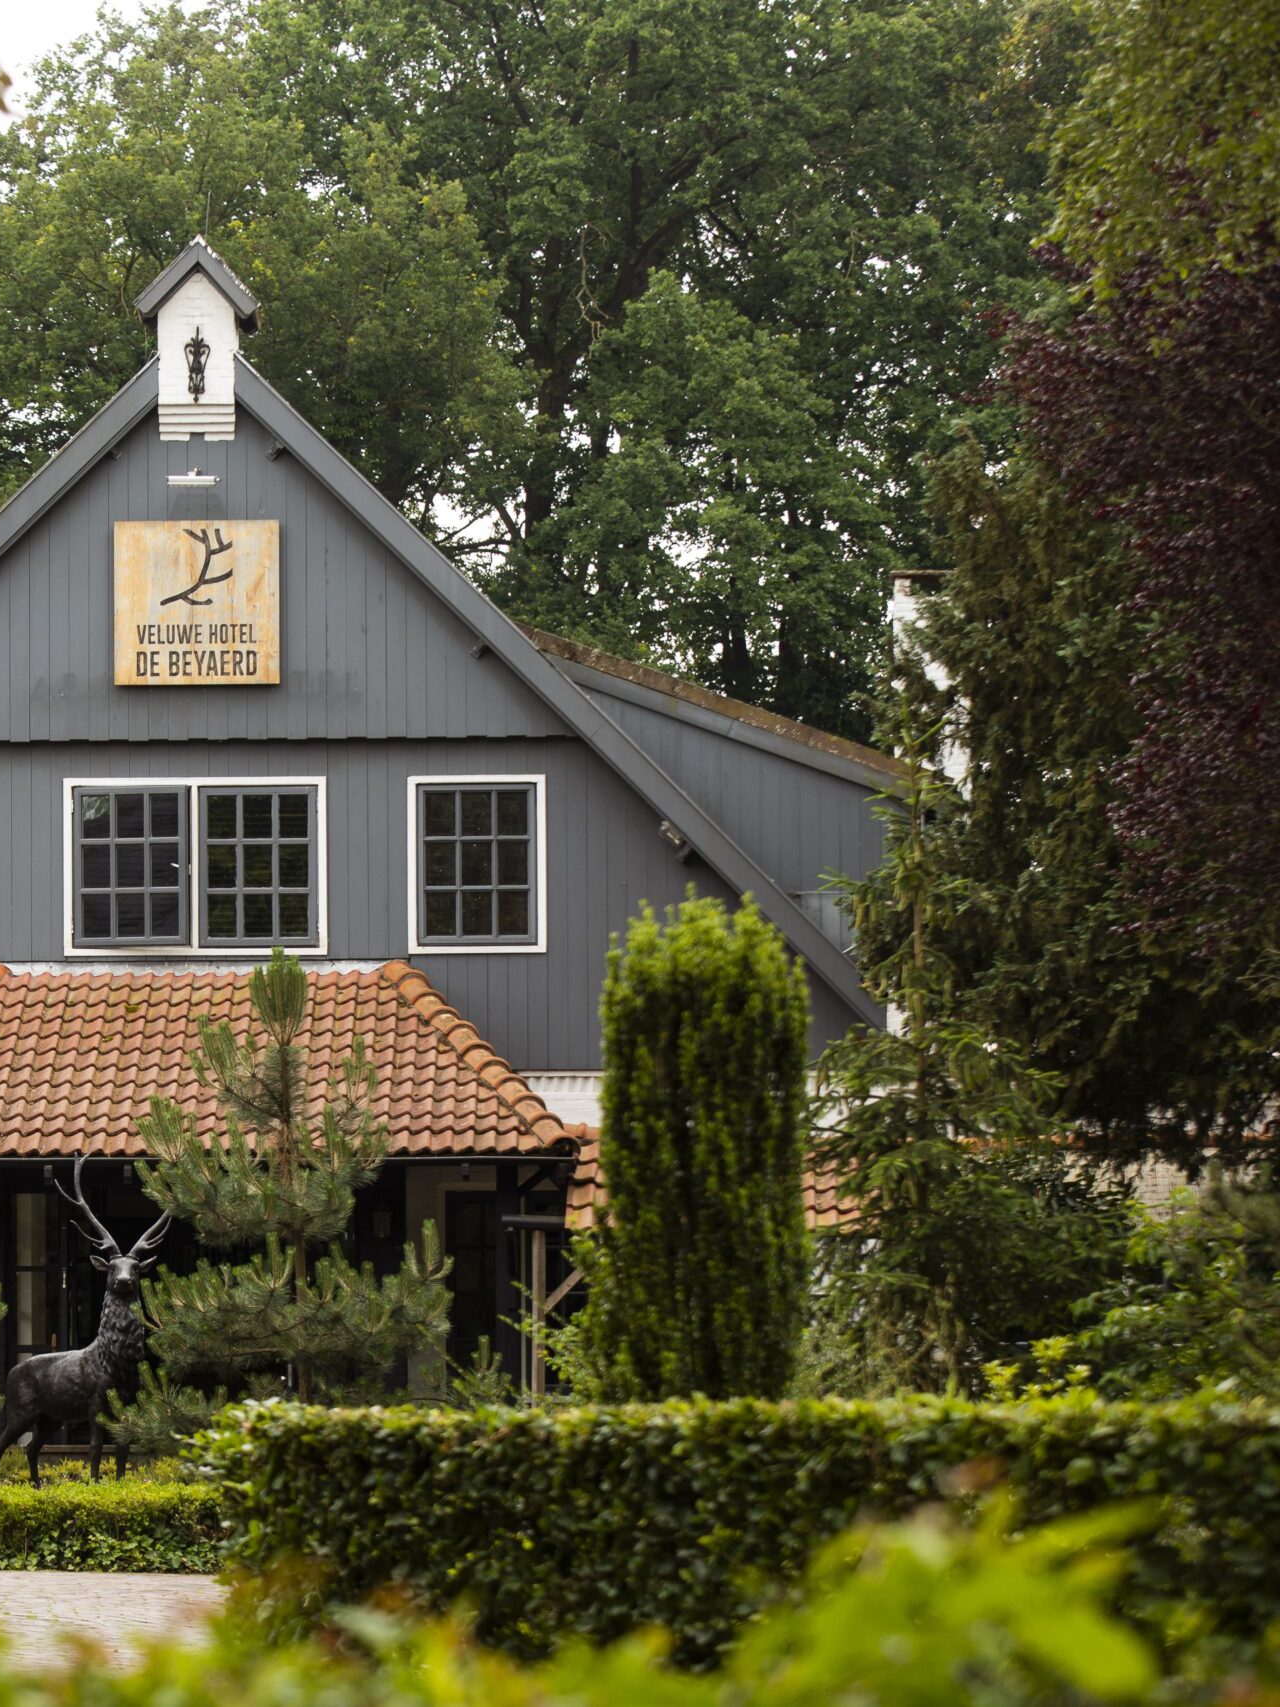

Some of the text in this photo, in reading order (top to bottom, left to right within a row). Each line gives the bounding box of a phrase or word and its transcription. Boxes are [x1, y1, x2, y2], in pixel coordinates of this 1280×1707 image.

[136, 623, 257, 645] VELUWE HOTEL
[136, 650, 257, 677] DE BEYAERD
